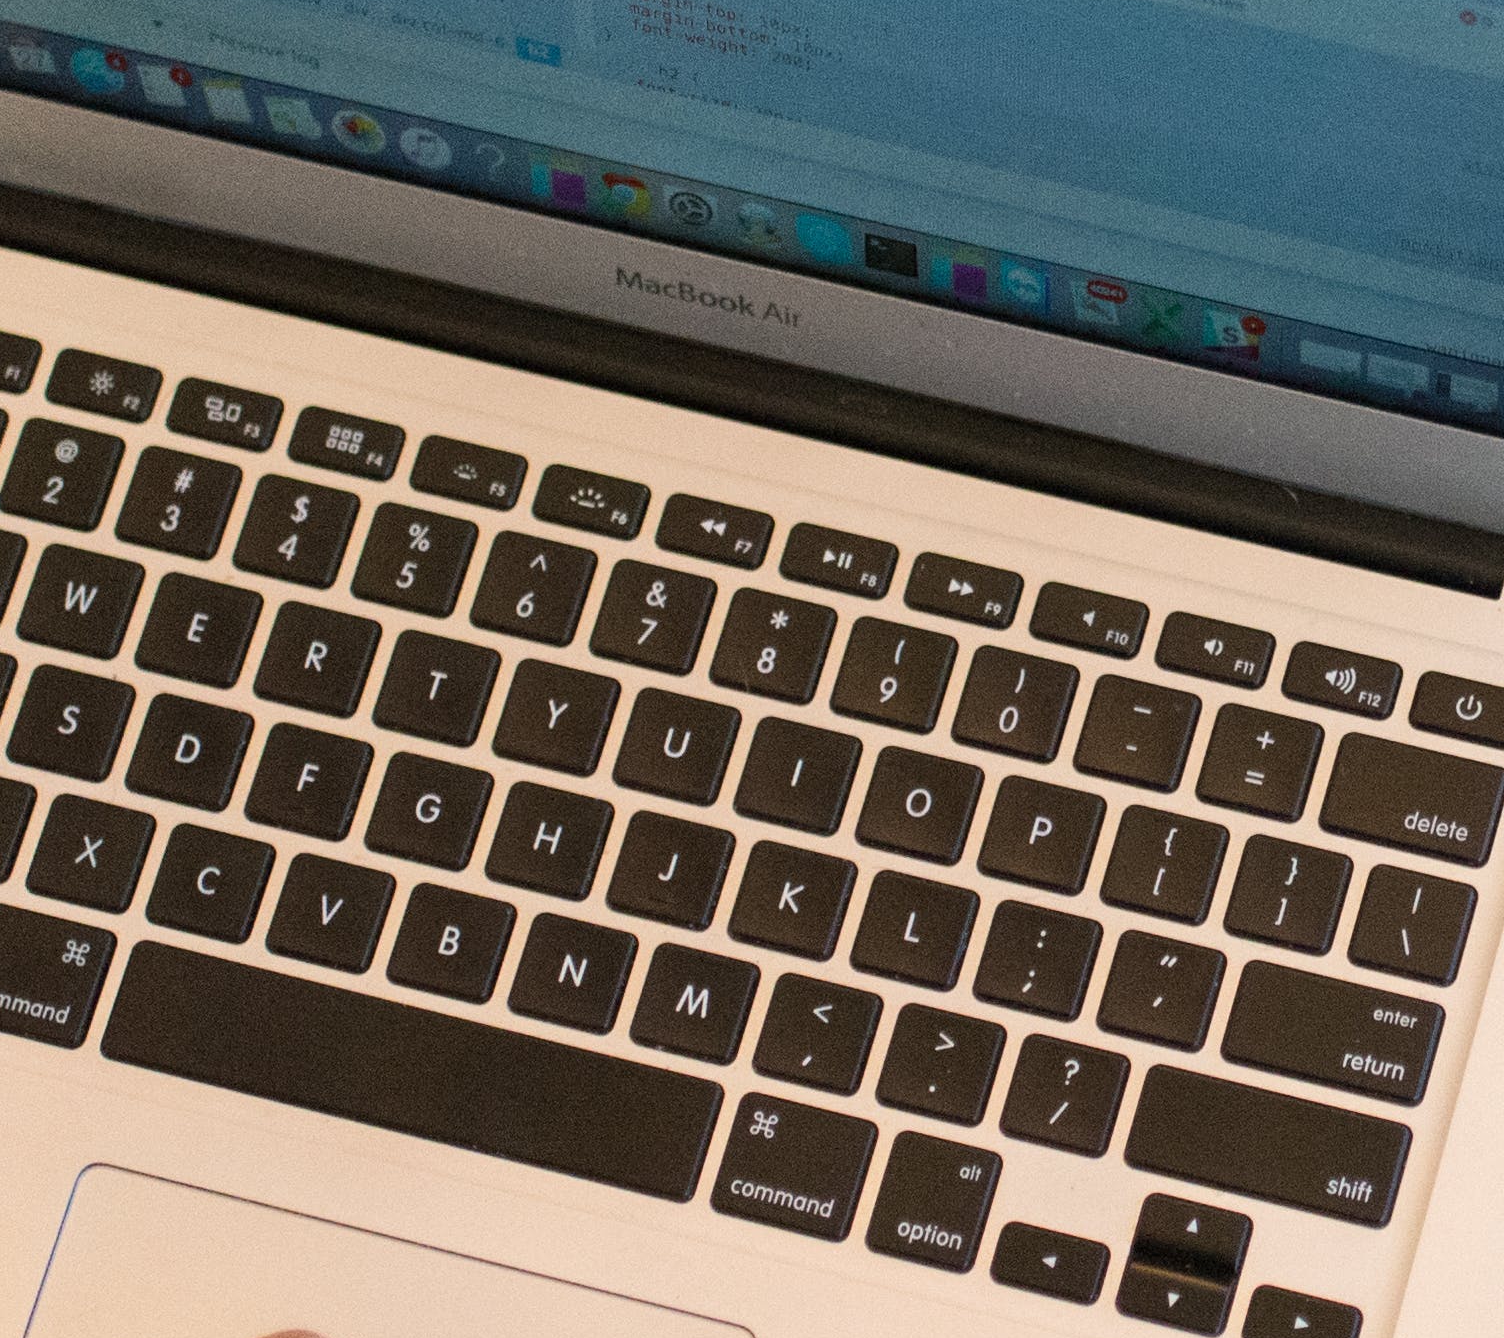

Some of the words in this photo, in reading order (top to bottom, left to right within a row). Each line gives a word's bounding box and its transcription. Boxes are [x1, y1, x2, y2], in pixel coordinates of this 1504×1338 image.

[613, 266, 757, 319] MacBook
[761, 294, 803, 330] Air
[41, 474, 65, 506] 2
[159, 503, 182, 533] 3
[276, 533, 300, 562] 4
[394, 560, 419, 590] 5
[63, 580, 99, 615] W
[514, 591, 535, 619] 6
[185, 611, 210, 644] E
[636, 616, 659, 646] 7
[303, 639, 329, 673] R
[755, 646, 778, 675] 8
[427, 668, 449, 701] T
[878, 675, 899, 704] 9
[56, 703, 82, 736] S
[547, 698, 570, 730] Y
[997, 705, 1020, 735] 0
[173, 732, 202, 765] D
[662, 726, 692, 760] U
[295, 761, 321, 793] F
[414, 792, 443, 825] G
[531, 820, 564, 856] H
[1027, 814, 1055, 846] P
[1403, 810, 1469, 843] delete
[73, 834, 104, 869] X
[657, 851, 680, 883] J
[195, 864, 222, 897] C
[320, 892, 345, 927] V
[777, 881, 806, 914] K
[437, 923, 462, 957] B
[902, 910, 921, 945] L
[557, 953, 589, 988] N
[674, 983, 710, 1019] M
[1372, 1007, 1419, 1029] enter
[1341, 1052, 1406, 1081] return
[958, 1163, 983, 1182] alt
[729, 1178, 836, 1219] command
[1326, 1176, 1373, 1203] shift
[896, 1219, 964, 1251] option
